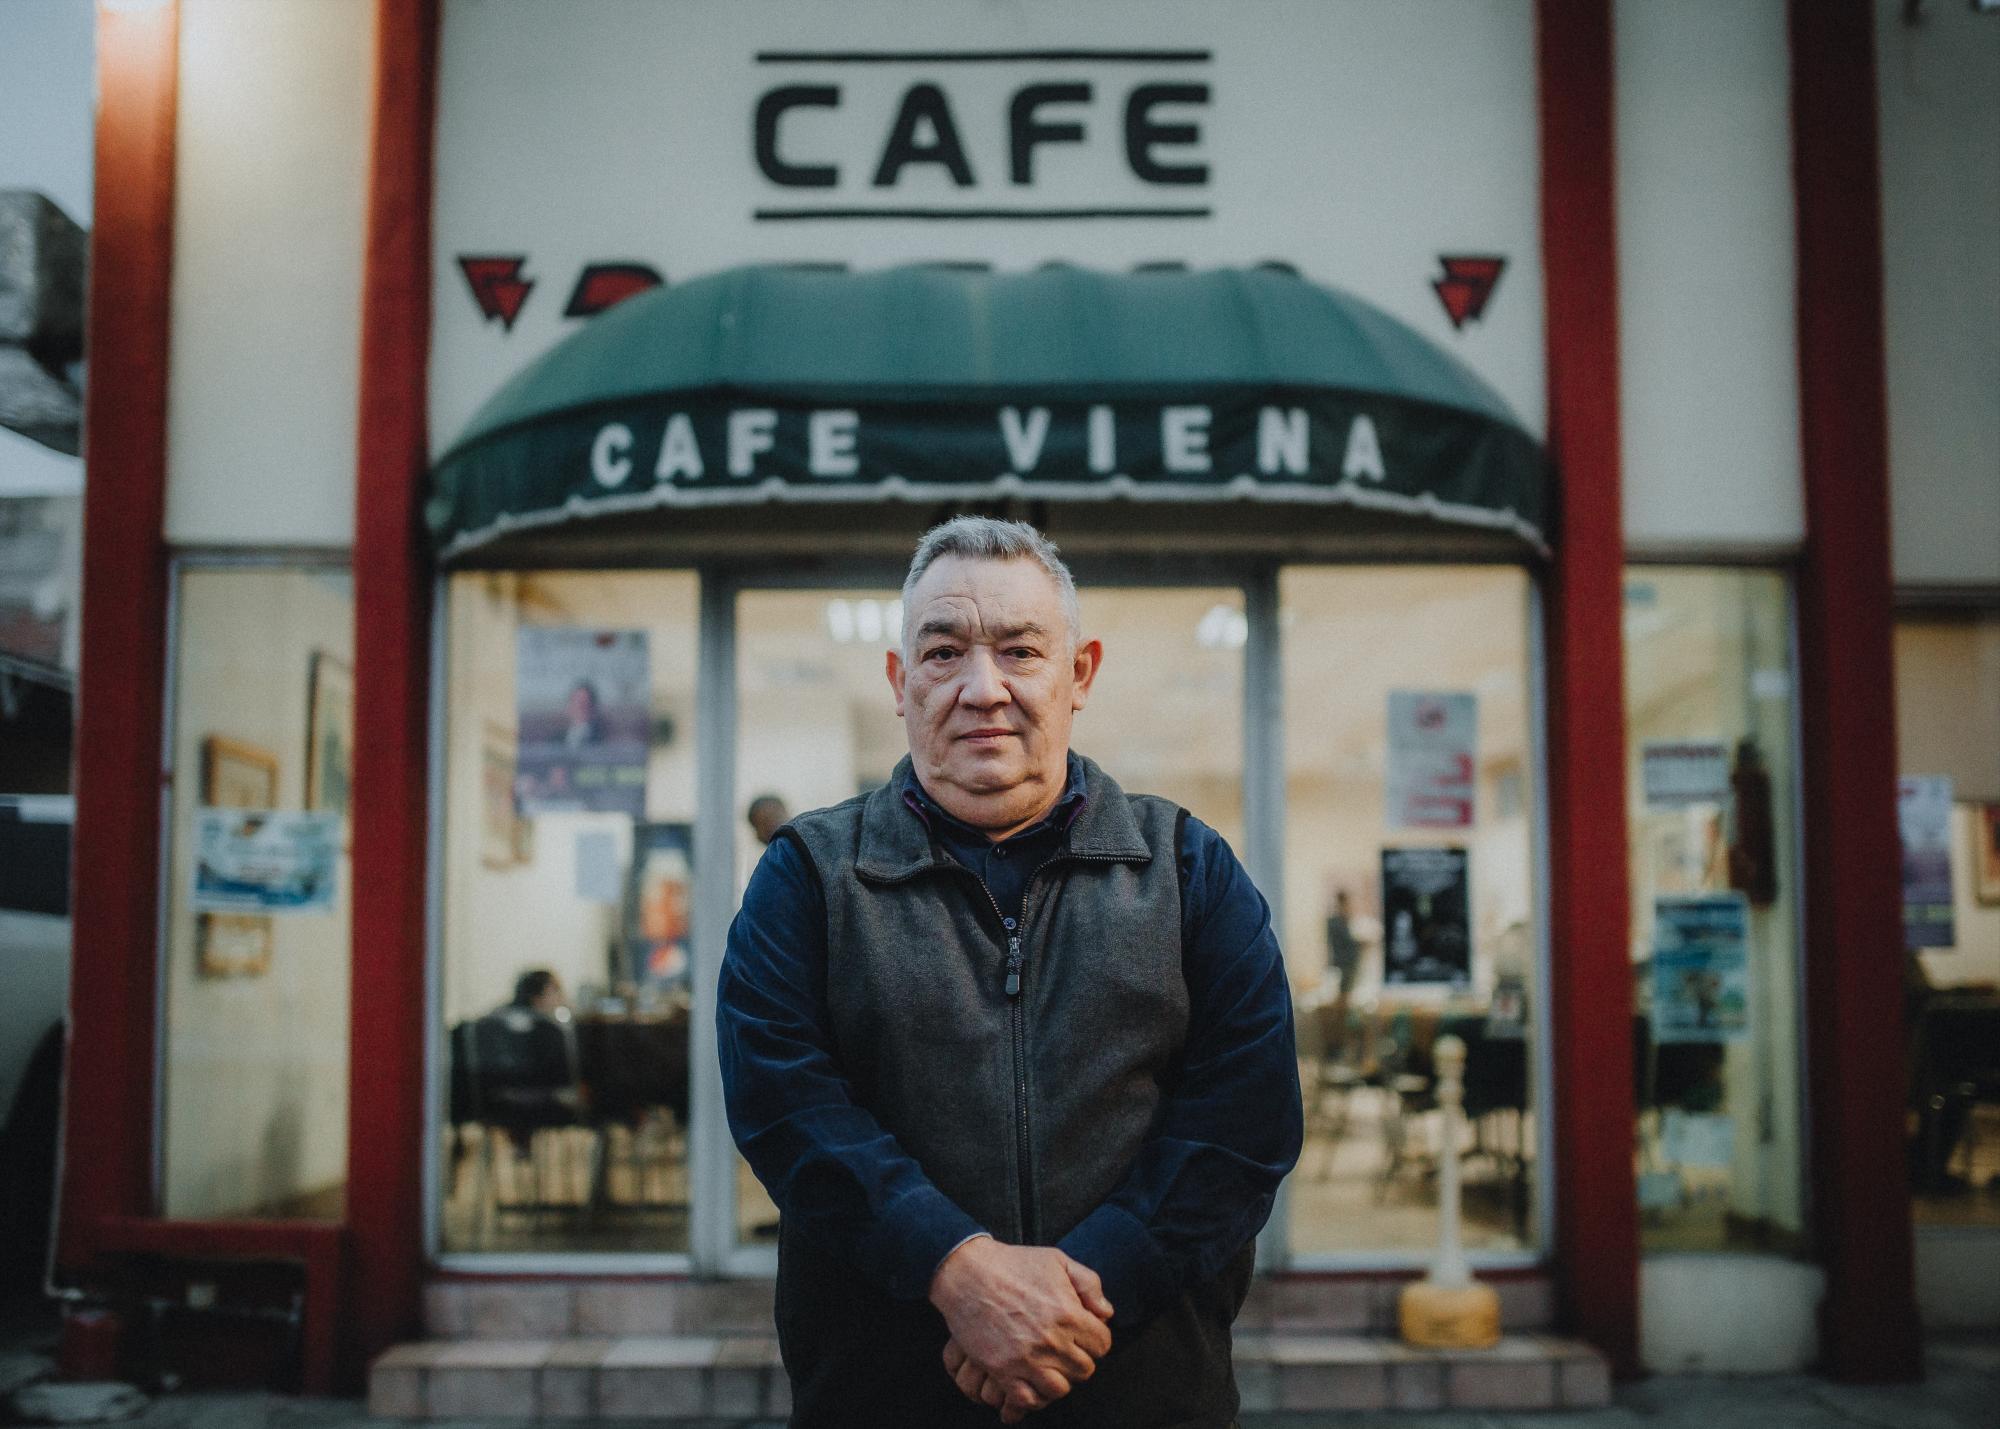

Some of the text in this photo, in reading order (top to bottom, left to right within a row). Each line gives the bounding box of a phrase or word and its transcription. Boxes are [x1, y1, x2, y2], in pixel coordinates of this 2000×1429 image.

[754, 81, 1209, 187] CAFE
[591, 405, 1385, 489] CAFE VIENA
